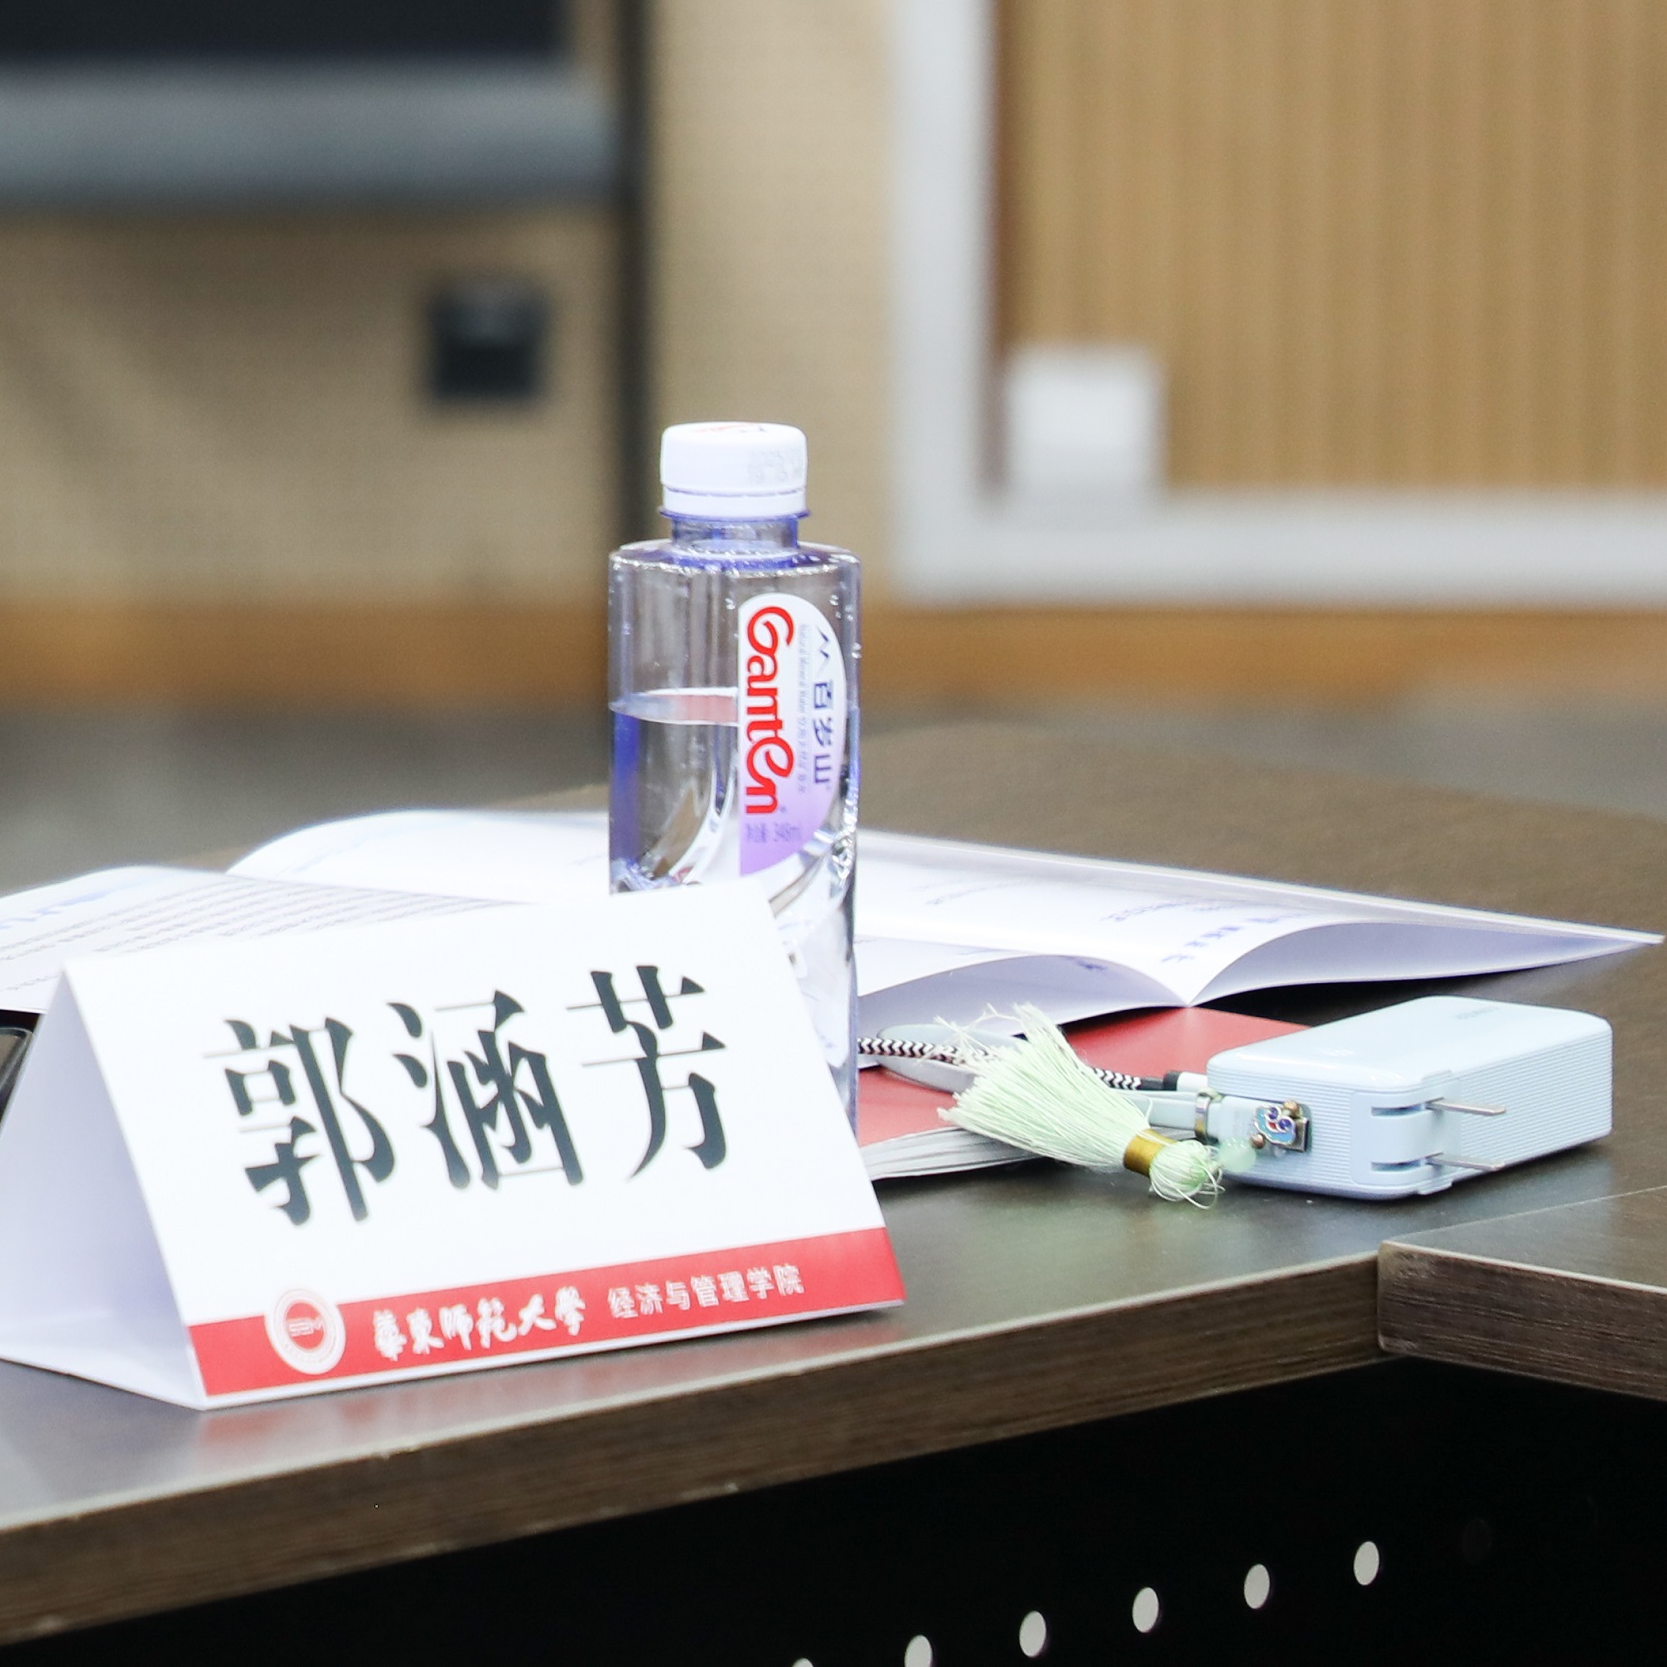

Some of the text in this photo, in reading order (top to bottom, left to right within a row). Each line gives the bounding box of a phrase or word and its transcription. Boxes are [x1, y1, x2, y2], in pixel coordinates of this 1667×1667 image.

[812, 679, 835, 784] 百岁山
[202, 963, 729, 1226] 郭涵芳
[606, 1261, 806, 1320] 经济与管理学院
